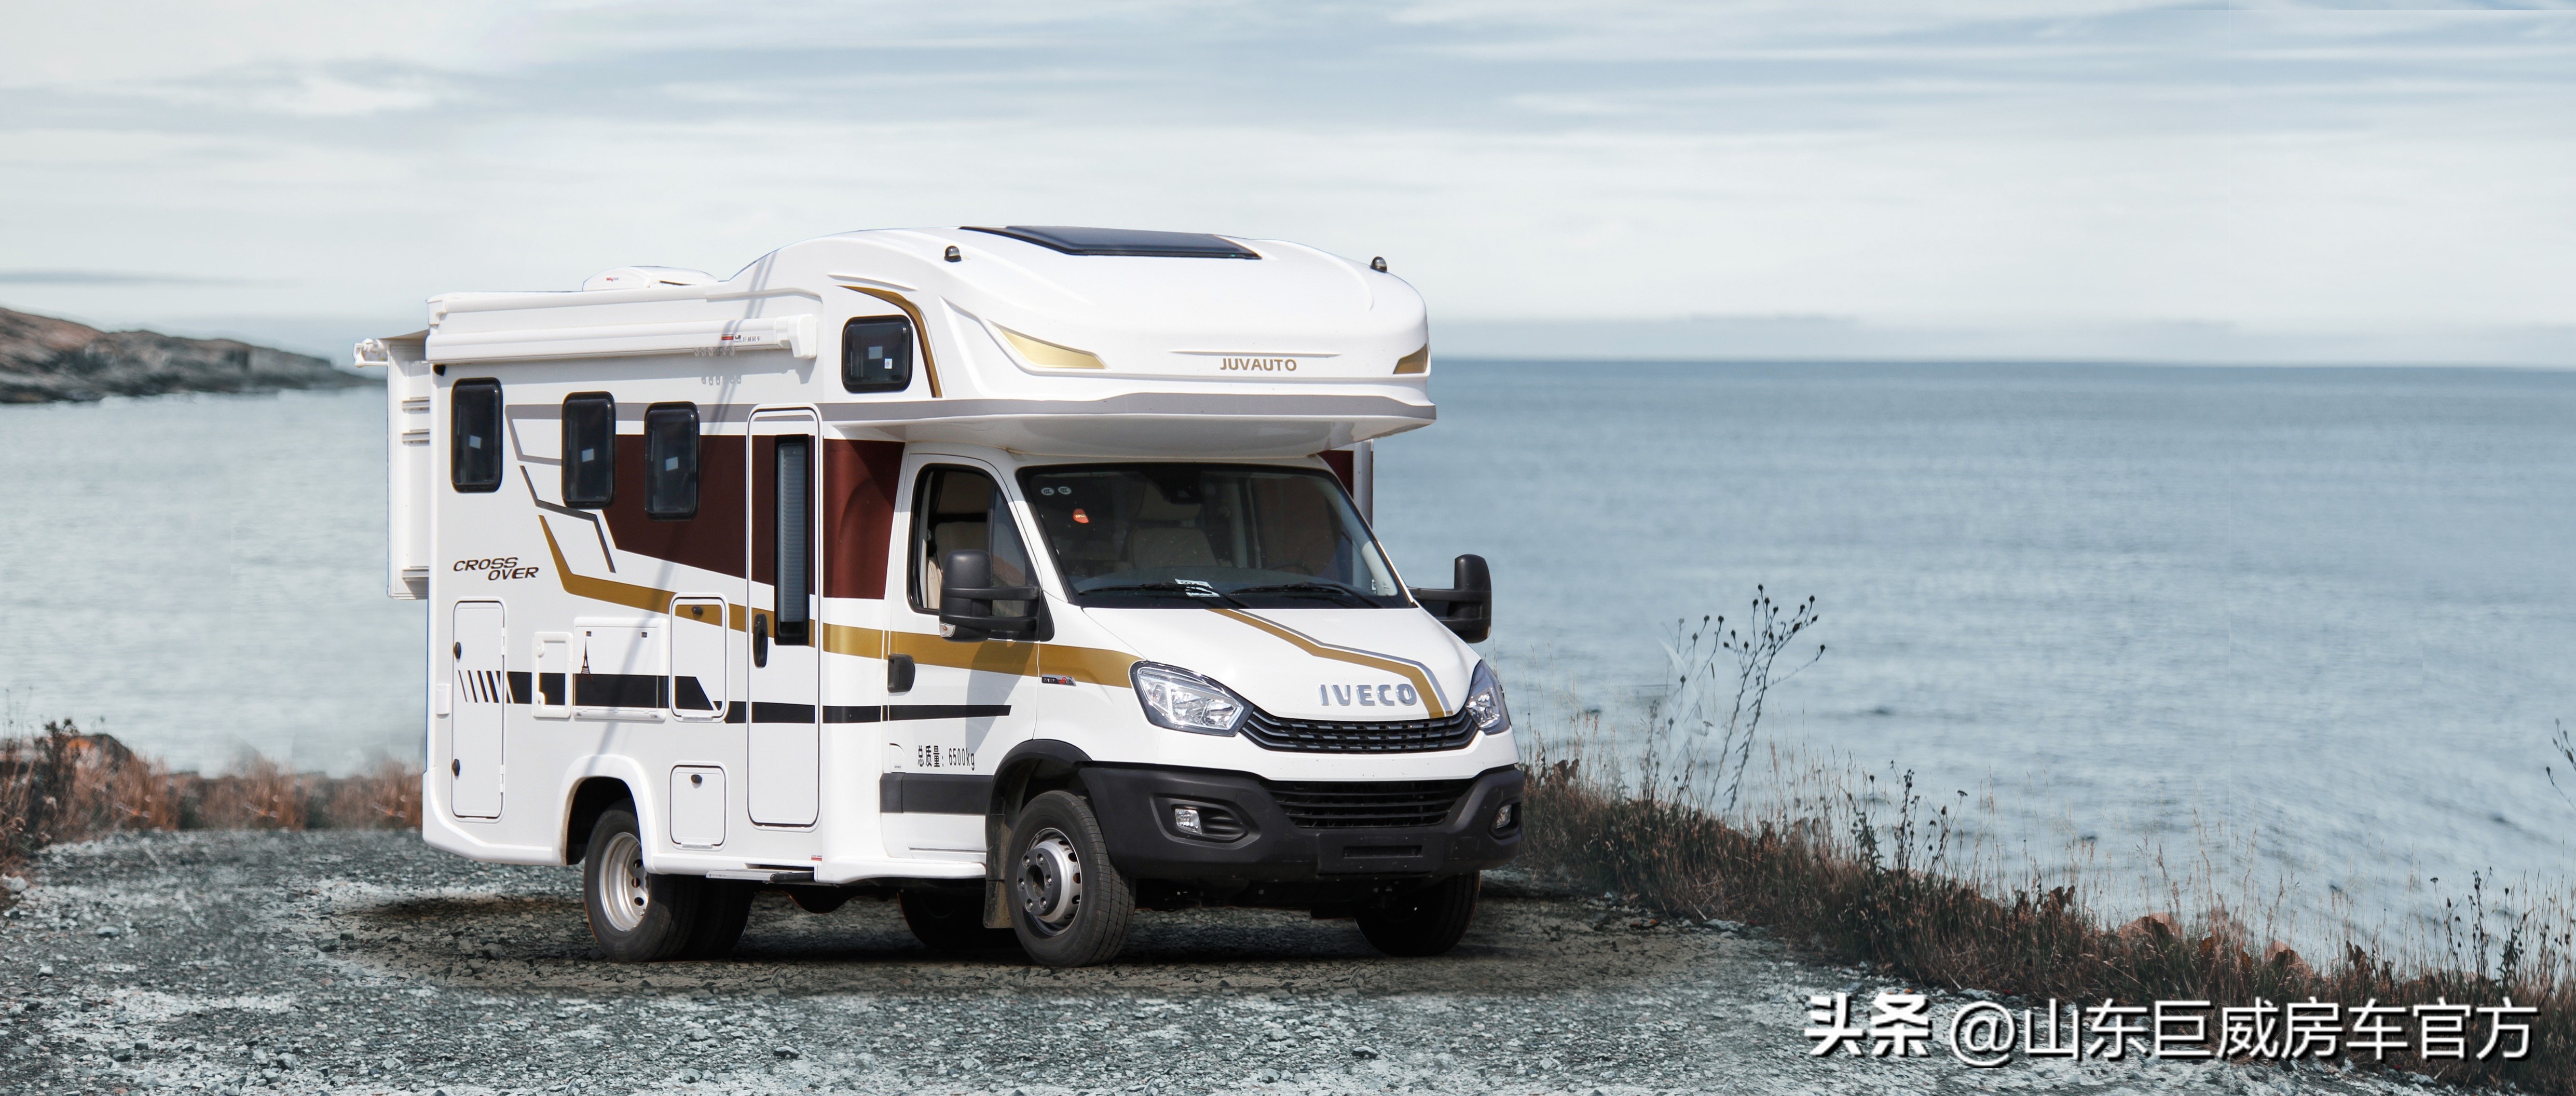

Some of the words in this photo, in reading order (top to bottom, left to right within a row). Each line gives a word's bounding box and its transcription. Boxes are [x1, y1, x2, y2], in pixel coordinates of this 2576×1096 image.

[1220, 358, 1297, 372] JUVAUTO
[453, 557, 518, 572] CROSS
[487, 567, 539, 581] OVER
[1318, 683, 1417, 706] IVECO
